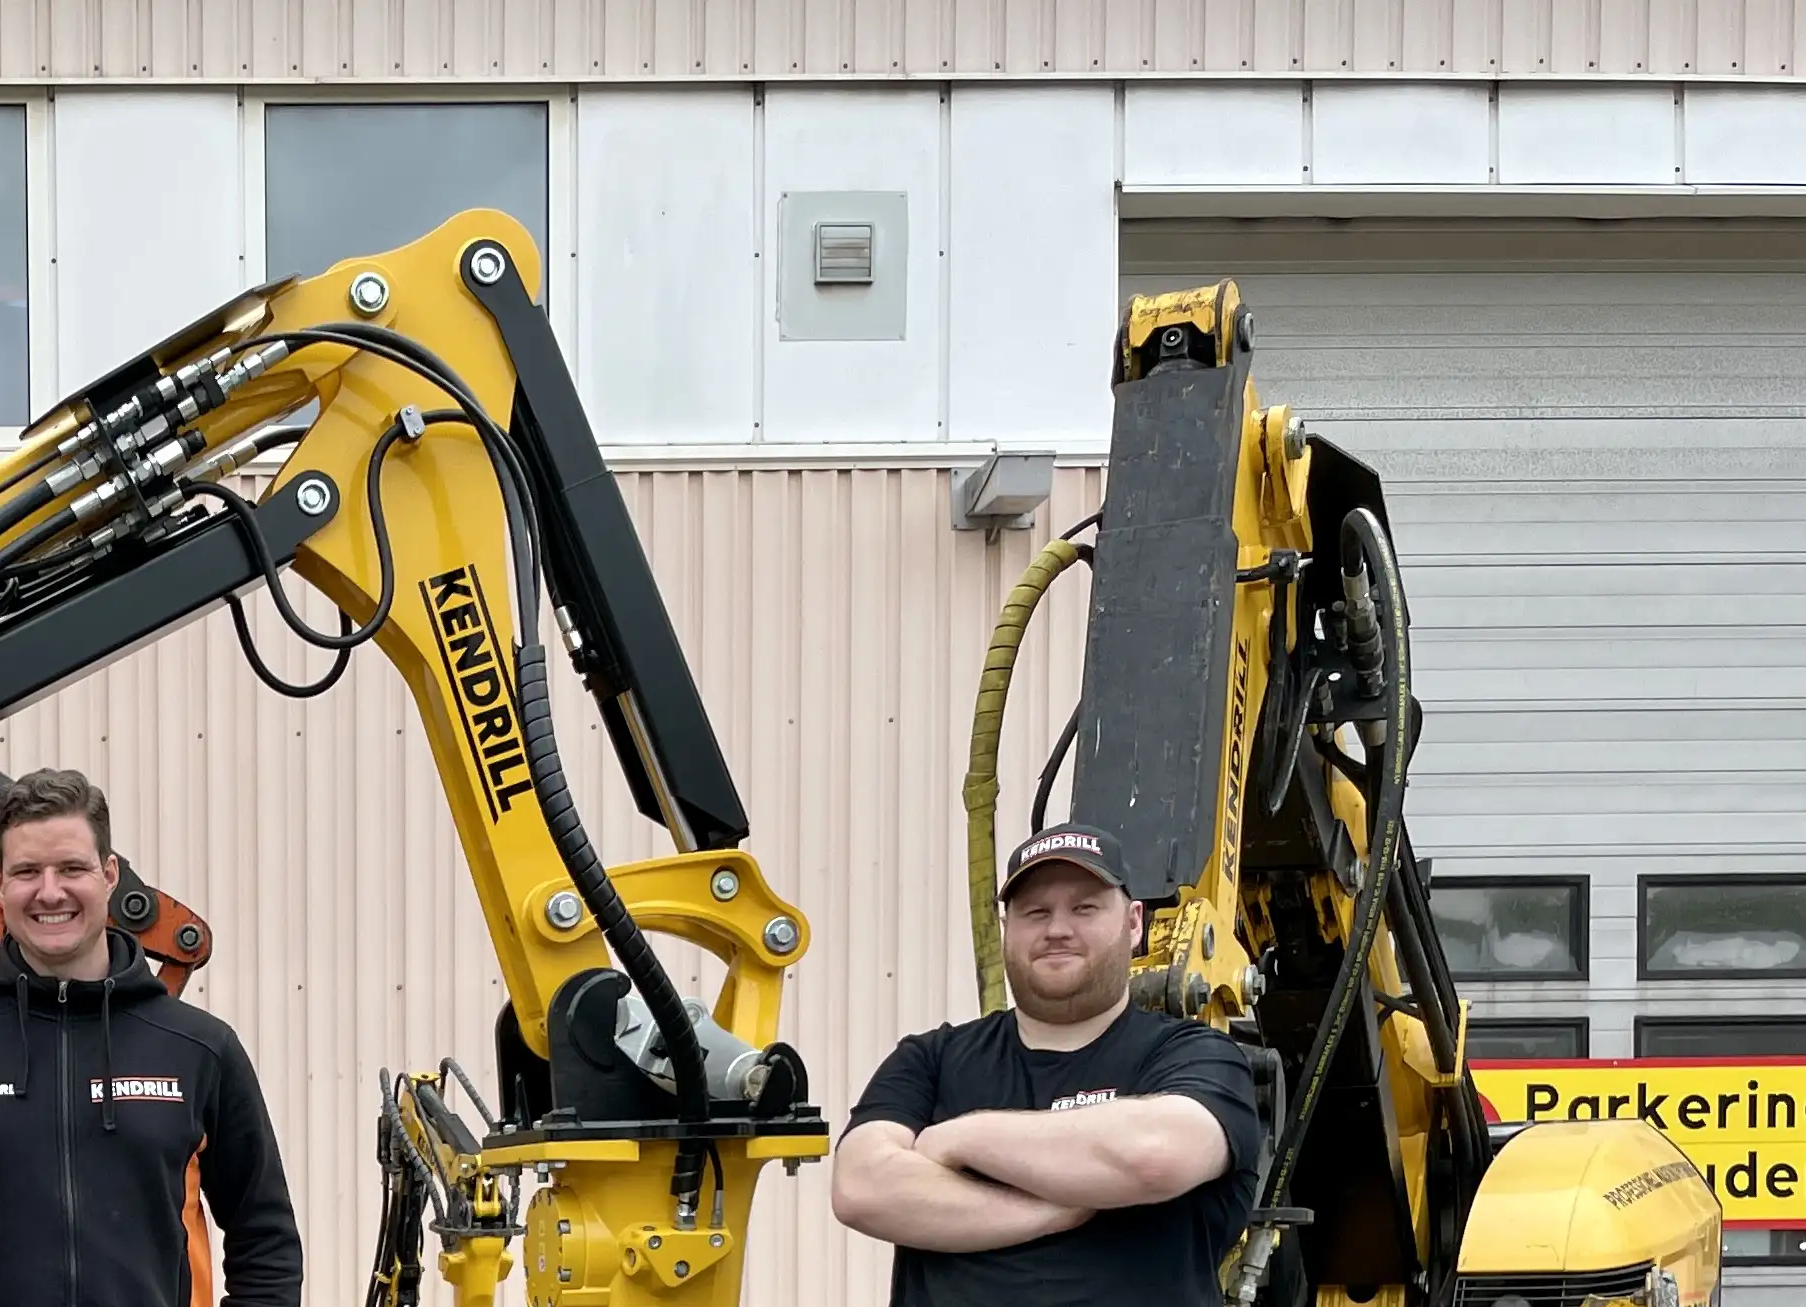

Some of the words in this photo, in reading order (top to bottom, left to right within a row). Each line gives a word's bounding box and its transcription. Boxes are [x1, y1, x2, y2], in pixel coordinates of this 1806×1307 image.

[430, 567, 533, 812] KENDRILL
[1223, 640, 1248, 886] KENDRILL
[1021, 835, 1101, 862] KENDRILL
[1526, 1080, 1806, 1129] Parkerin
